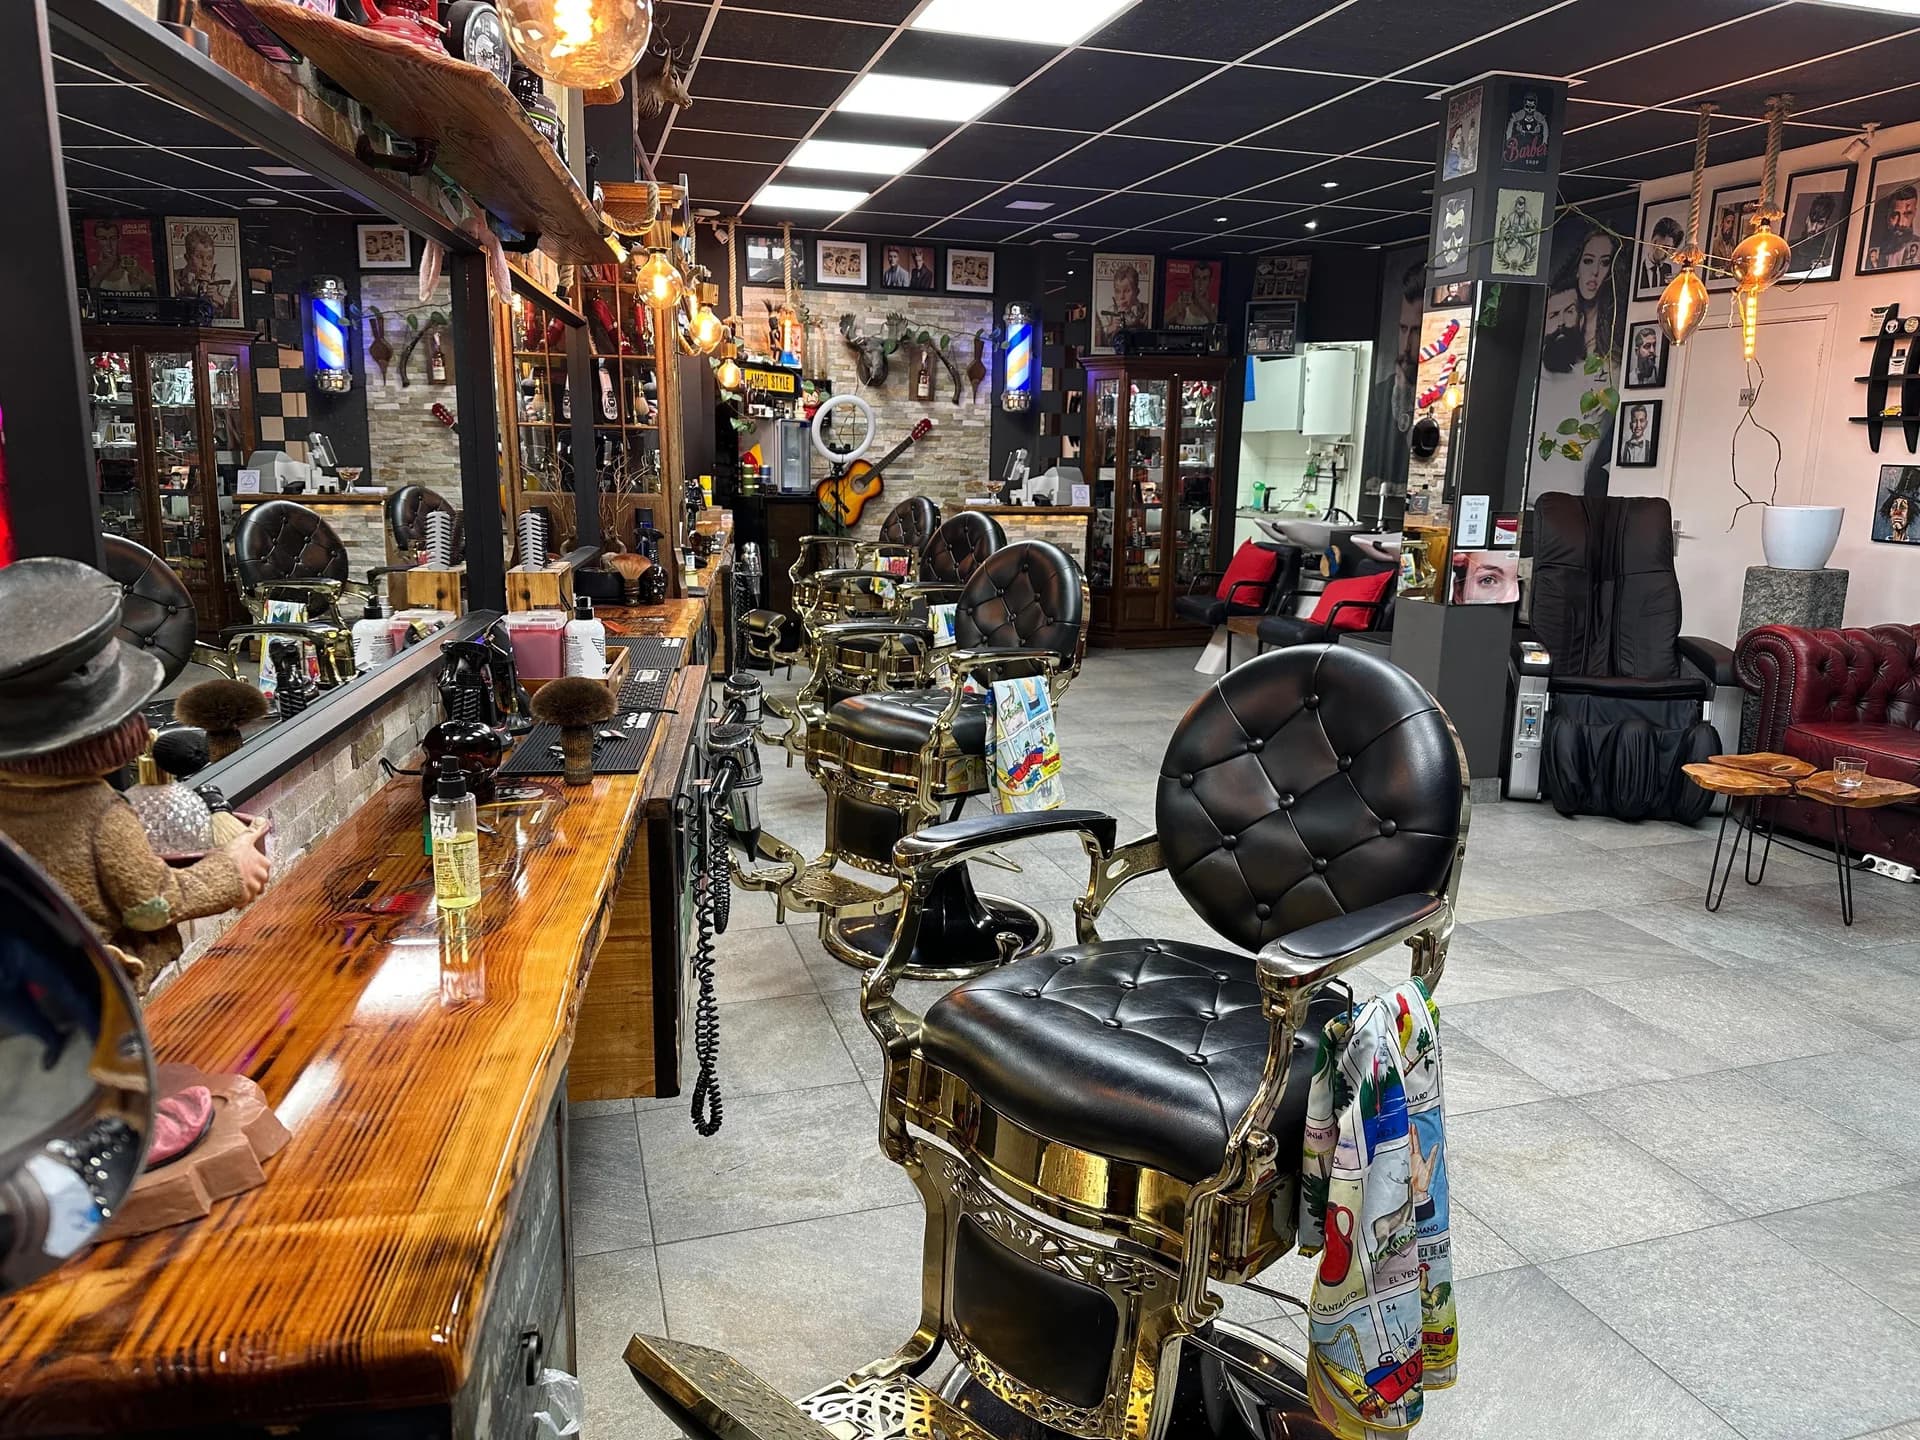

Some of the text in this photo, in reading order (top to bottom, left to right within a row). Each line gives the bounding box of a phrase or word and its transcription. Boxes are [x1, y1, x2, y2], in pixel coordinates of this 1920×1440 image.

[1504, 136, 1548, 162] Barber
[771, 375, 790, 391] STYLE
[1740, 393, 1754, 401] WC
[1352, 1039, 1360, 1048] 19
[1406, 1092, 1428, 1104] AJARO
[1389, 1269, 1419, 1285] EL VEN
[1317, 1291, 1358, 1313] CANTARITO
[1386, 1303, 1397, 1313] 54
[1425, 1334, 1449, 1344] LLO
